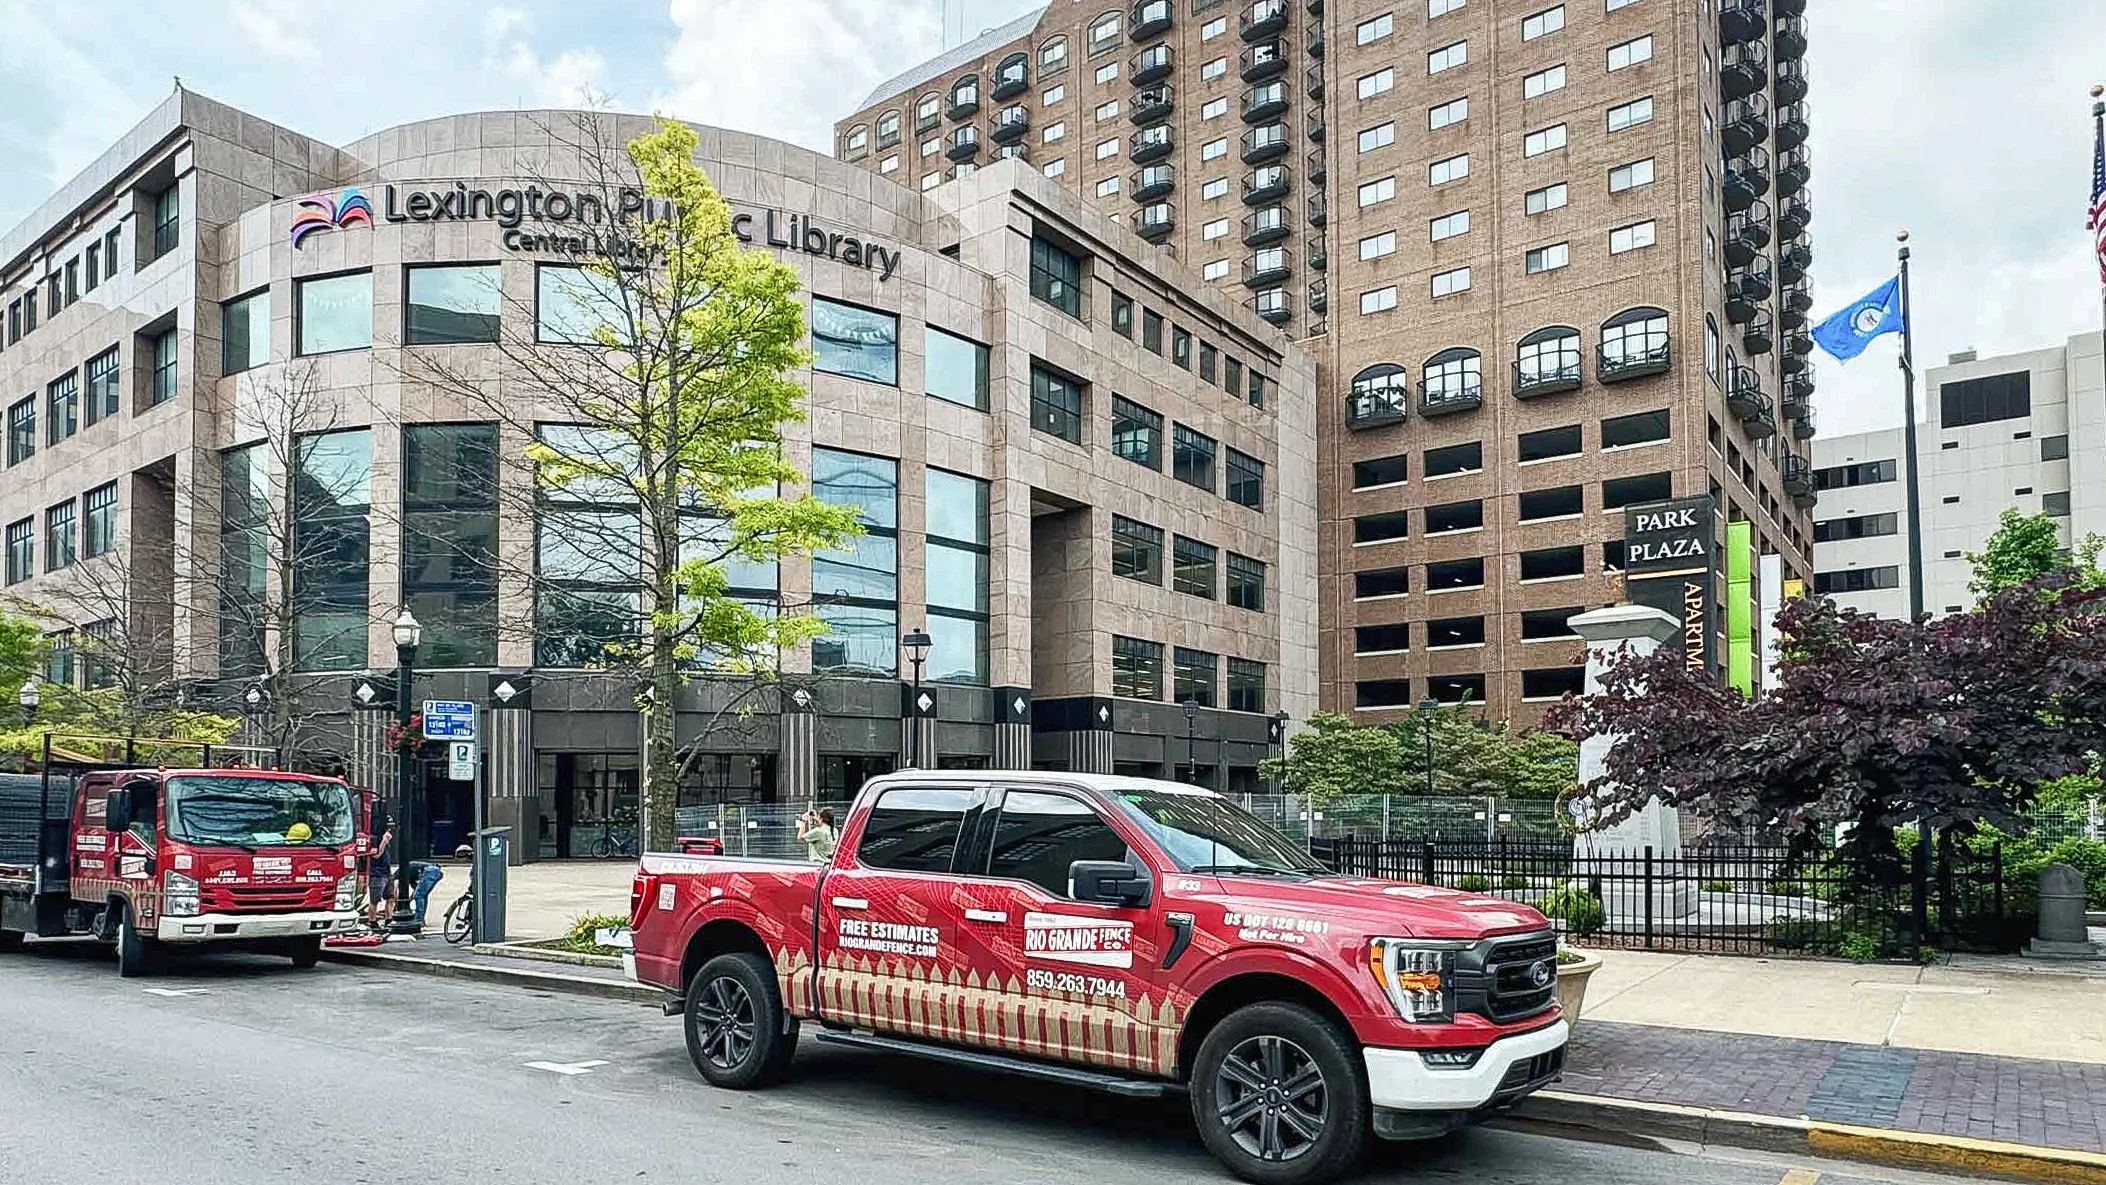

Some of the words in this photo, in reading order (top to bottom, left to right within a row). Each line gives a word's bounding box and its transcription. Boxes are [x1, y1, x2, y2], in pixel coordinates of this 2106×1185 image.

[384, 180, 600, 229] Lexington
[618, 187, 753, 242] Puc
[767, 209, 900, 281] Library
[503, 229, 588, 254] Central
[1636, 508, 1698, 532] PARK
[1630, 538, 1705, 562] PLAZA
[1684, 581, 1704, 673] APARTM
[840, 919, 869, 937] FREE
[871, 922, 939, 944] ESTIMATES
[1223, 912, 1242, 926] US
[1243, 913, 1268, 928] DOT
[839, 935, 937, 957] RIOGRANDEFENCE.COM
[1026, 929, 1046, 951] RIO
[1048, 929, 1099, 951] GRANDE
[1099, 928, 1131, 944] FENCE
[1103, 941, 1126, 950] CO.
[1259, 929, 1280, 940] For
[1279, 931, 1305, 944] Hire
[1026, 969, 1125, 999] 859.263.7944
